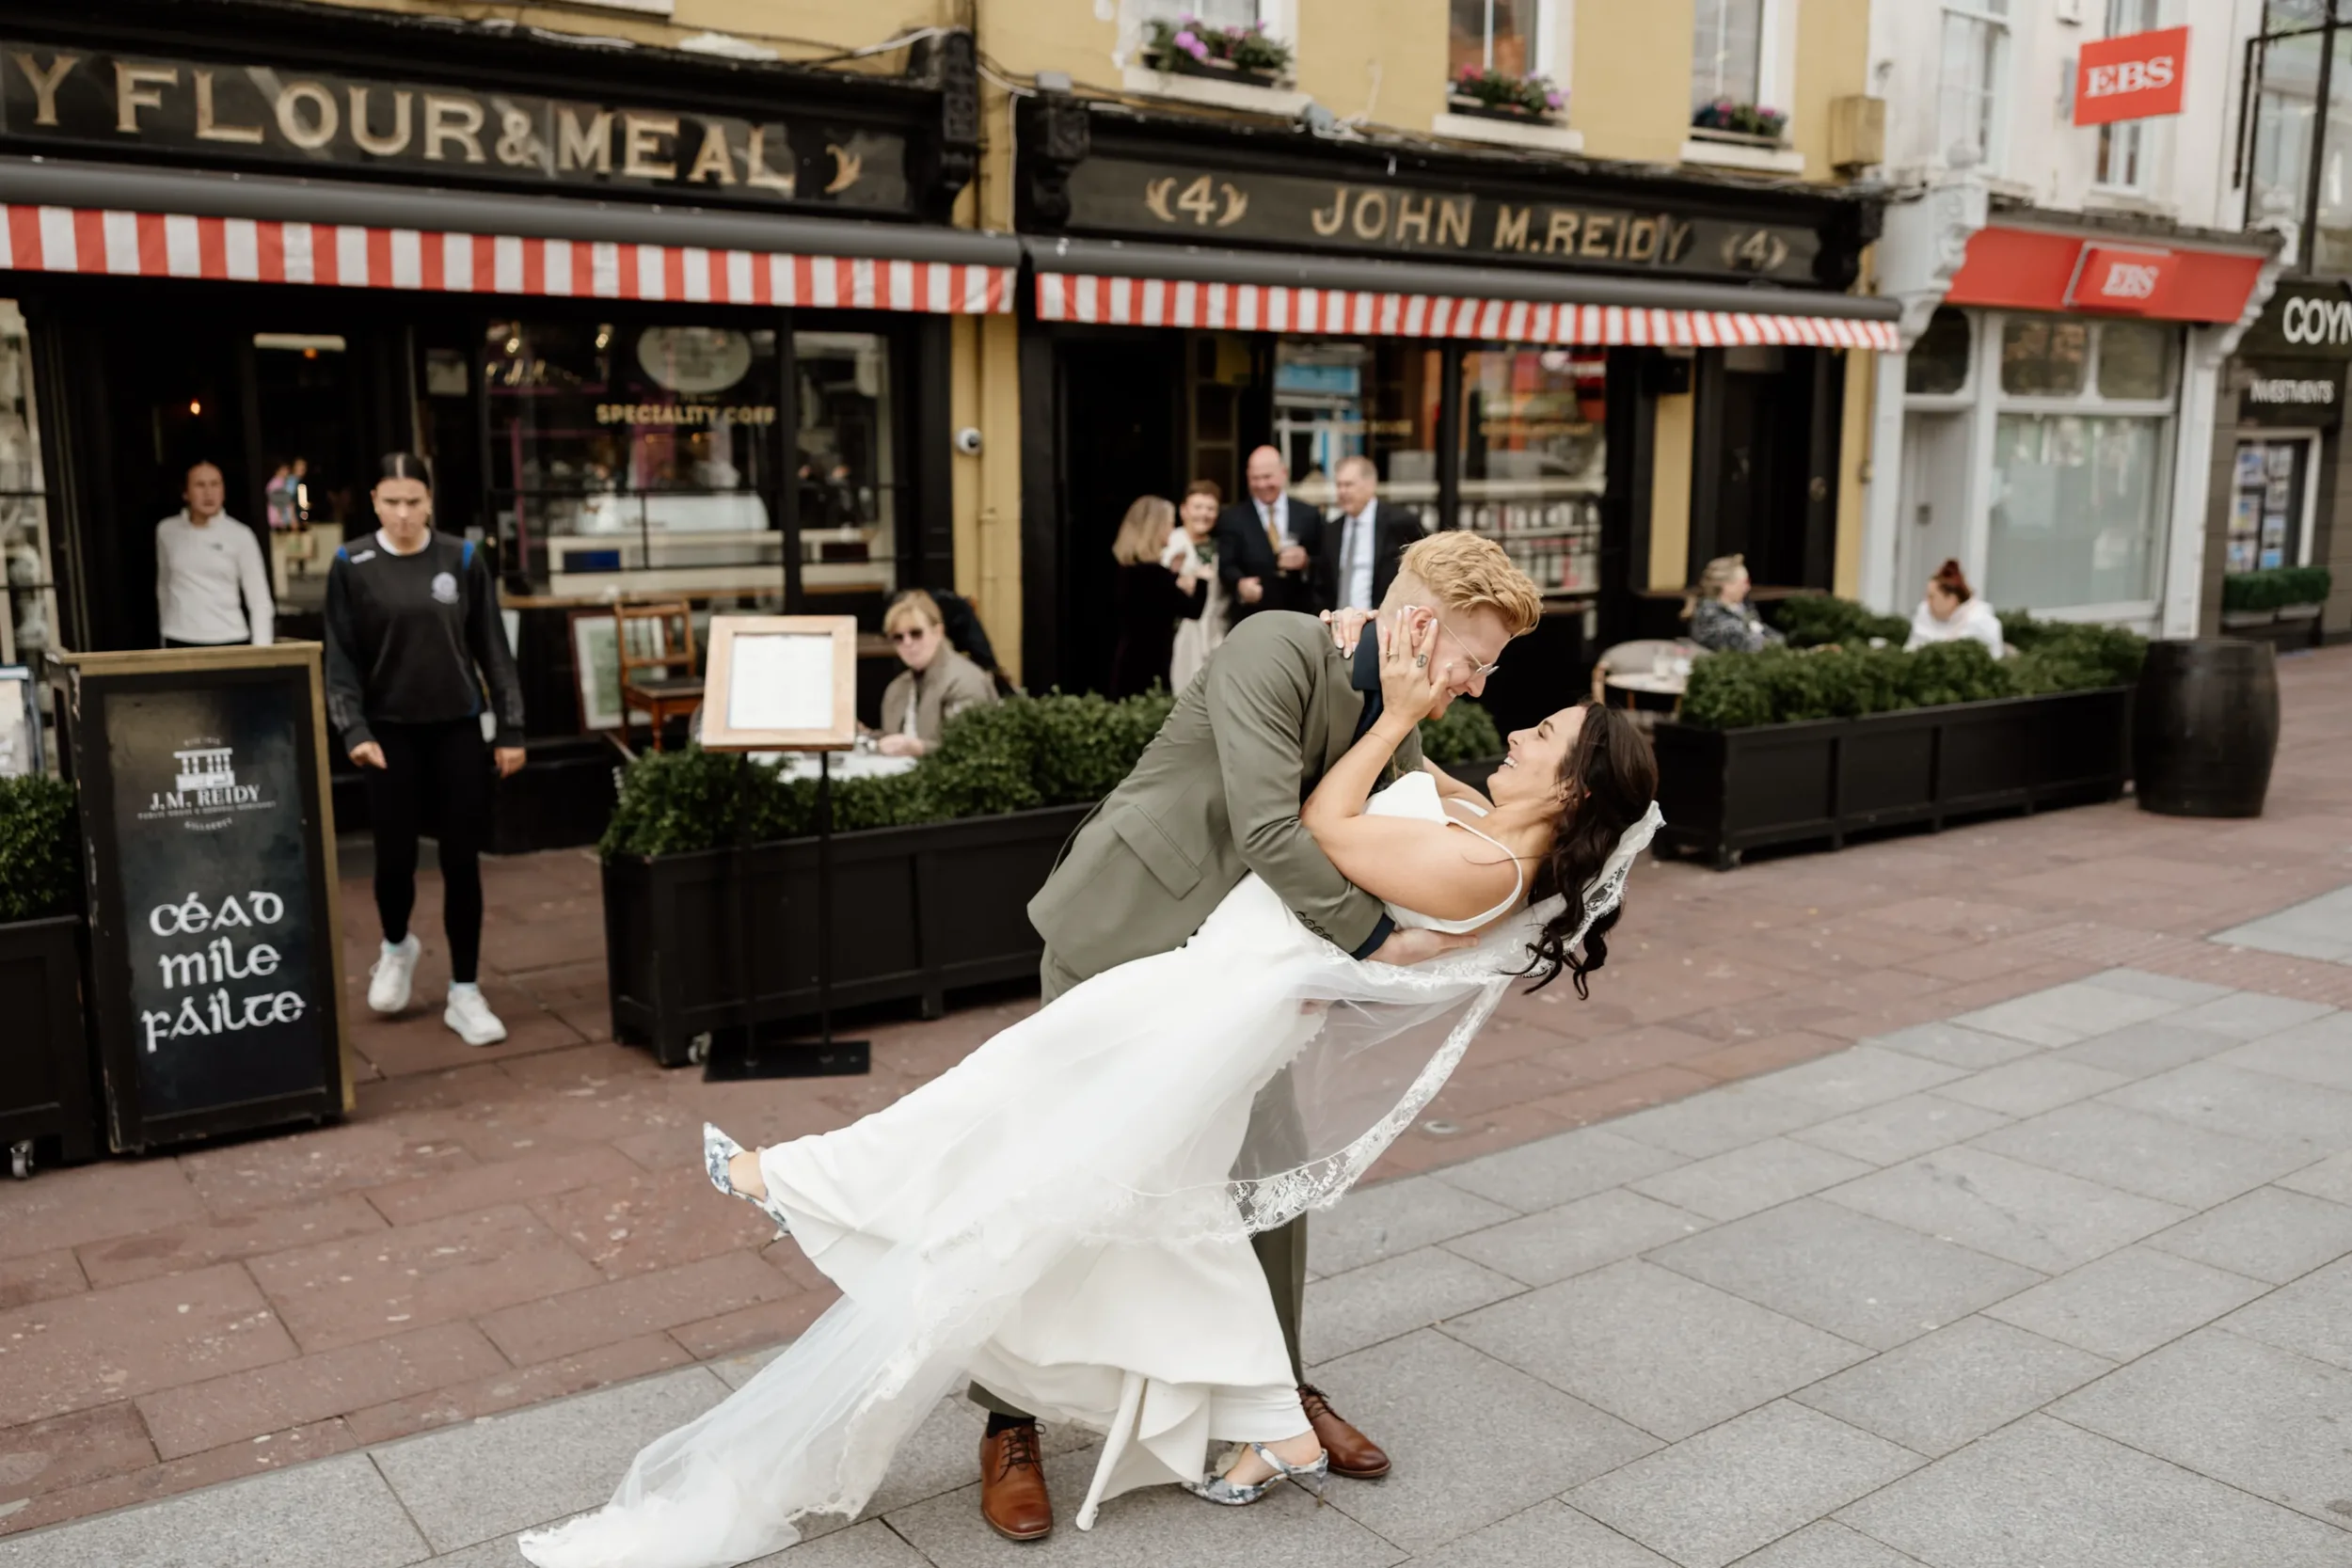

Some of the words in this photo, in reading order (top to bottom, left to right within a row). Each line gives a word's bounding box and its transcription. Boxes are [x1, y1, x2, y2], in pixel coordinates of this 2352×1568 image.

[2085, 55, 2174, 99] EBS
[113, 60, 487, 164] FLOUR
[495, 105, 542, 167] &
[556, 105, 797, 188] MEAL
[1311, 188, 1475, 246] JOHN
[2100, 261, 2160, 300] EBS
[595, 404, 718, 425] SPECIALITY
[197, 784, 262, 807] REIDY
